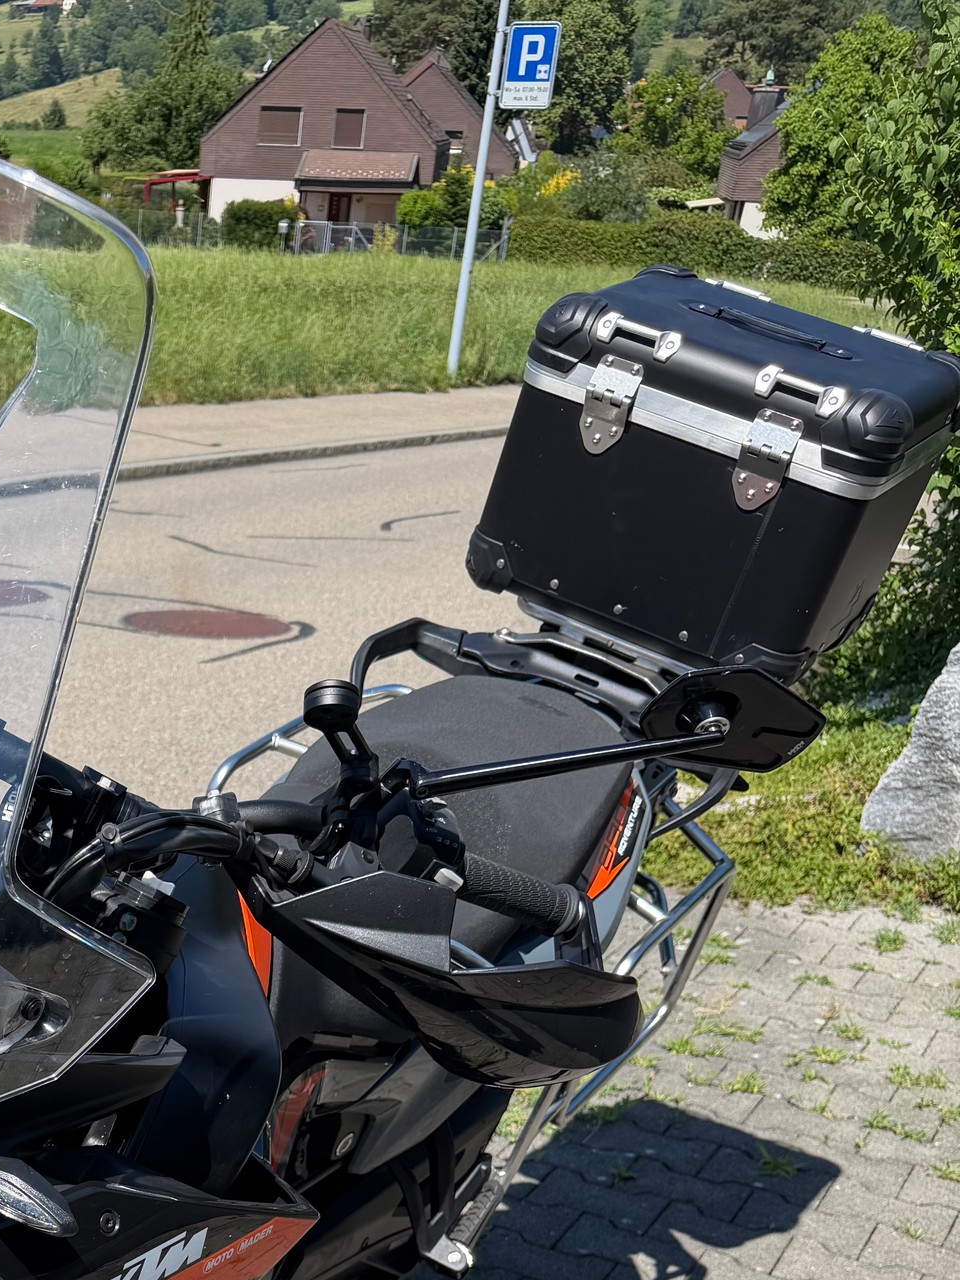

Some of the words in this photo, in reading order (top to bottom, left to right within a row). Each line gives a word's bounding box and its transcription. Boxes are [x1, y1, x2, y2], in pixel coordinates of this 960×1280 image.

[518, 34, 546, 76] P
[617, 795, 643, 856] ADVENTURE
[203, 1248, 235, 1274] MOTO
[237, 1225, 274, 1254] MADER
